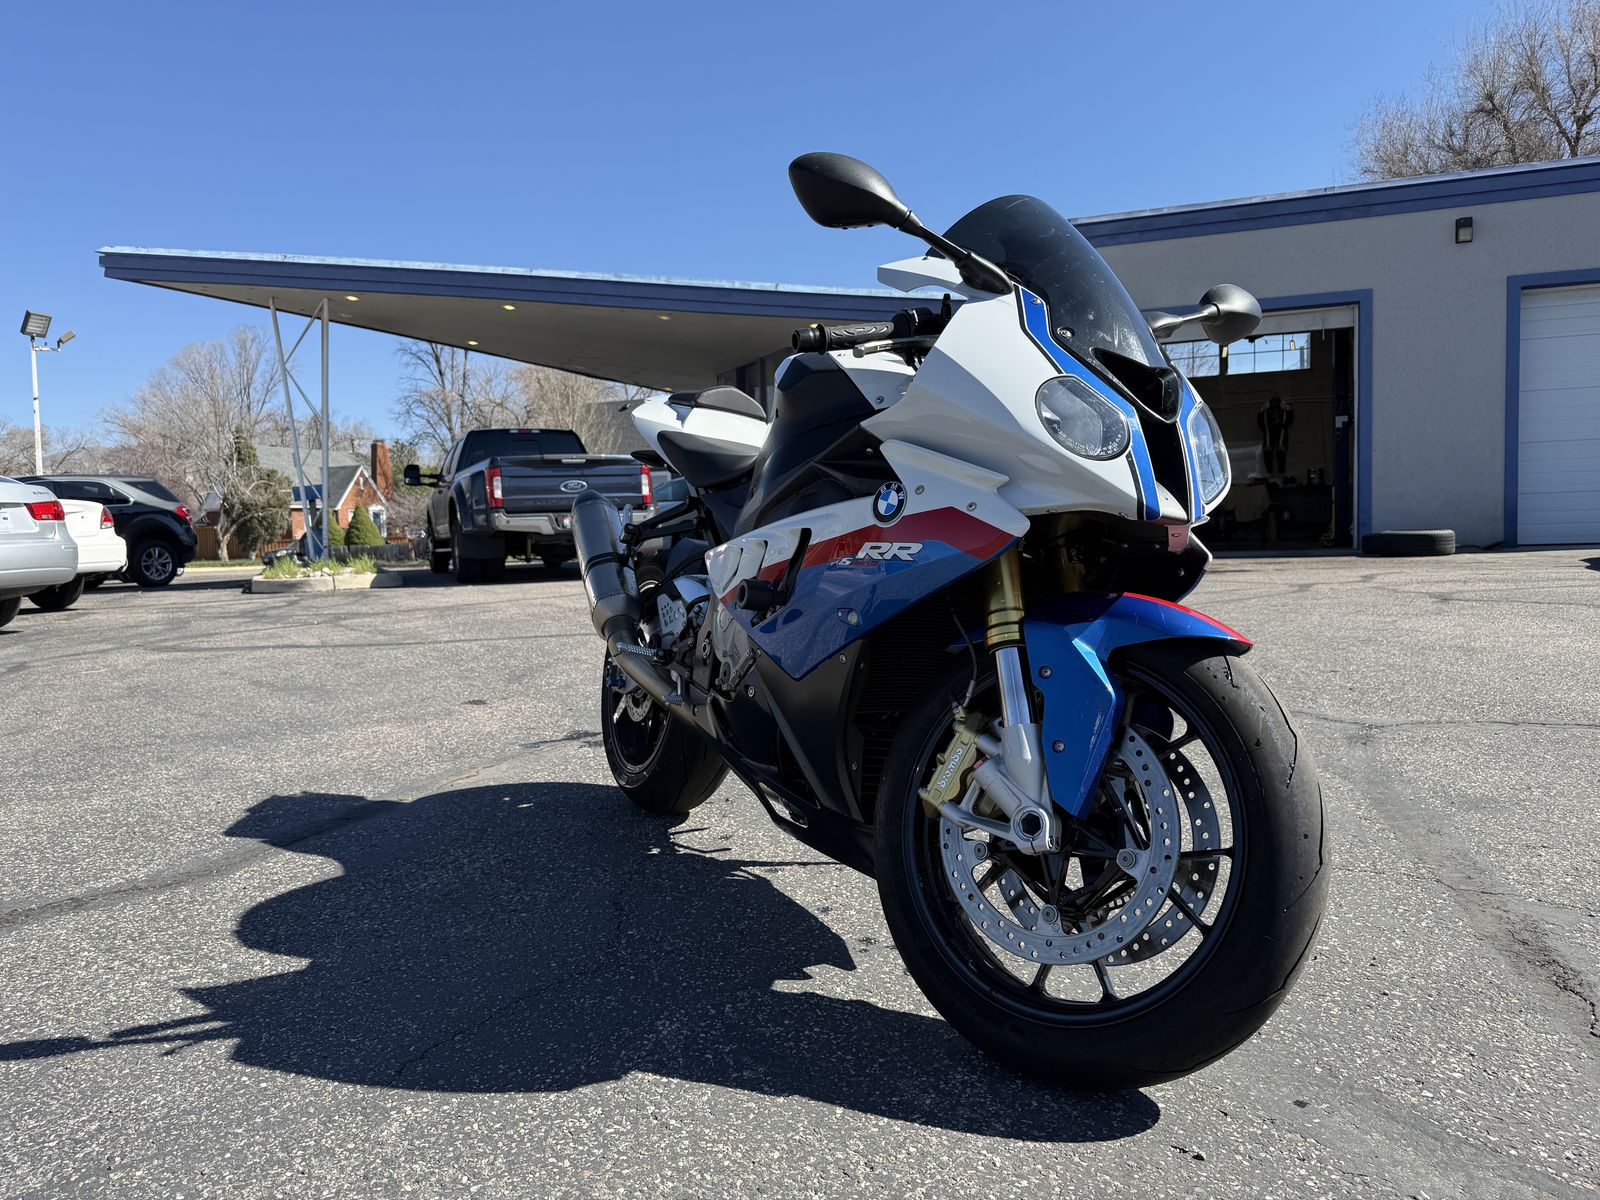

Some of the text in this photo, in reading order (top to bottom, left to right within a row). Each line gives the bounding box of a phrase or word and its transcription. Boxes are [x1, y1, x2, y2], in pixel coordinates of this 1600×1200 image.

[880, 483, 905, 500] BMW
[855, 541, 924, 561] RR
[937, 747, 963, 788] brembo
